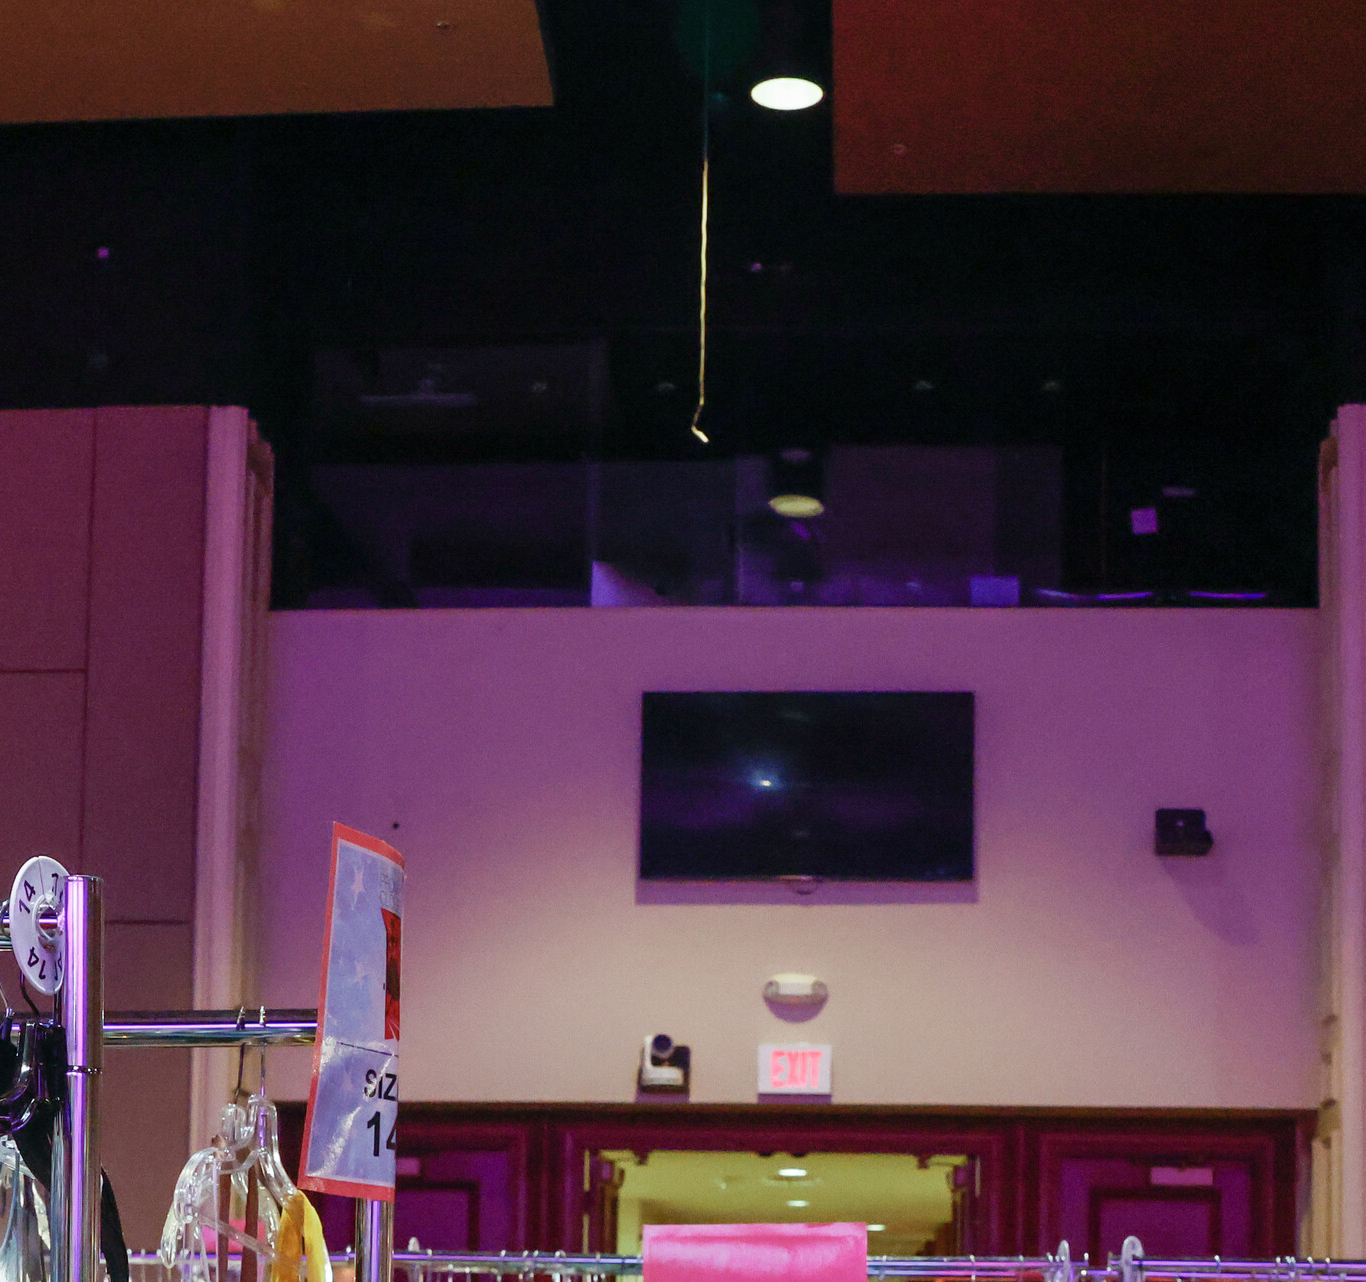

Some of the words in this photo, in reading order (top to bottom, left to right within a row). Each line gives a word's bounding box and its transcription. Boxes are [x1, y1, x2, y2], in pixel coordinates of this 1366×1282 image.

[18, 879, 37, 915] 14
[27, 946, 47, 981] 14
[363, 1068, 398, 1102] SIZ
[770, 1050, 824, 1088] EXIT
